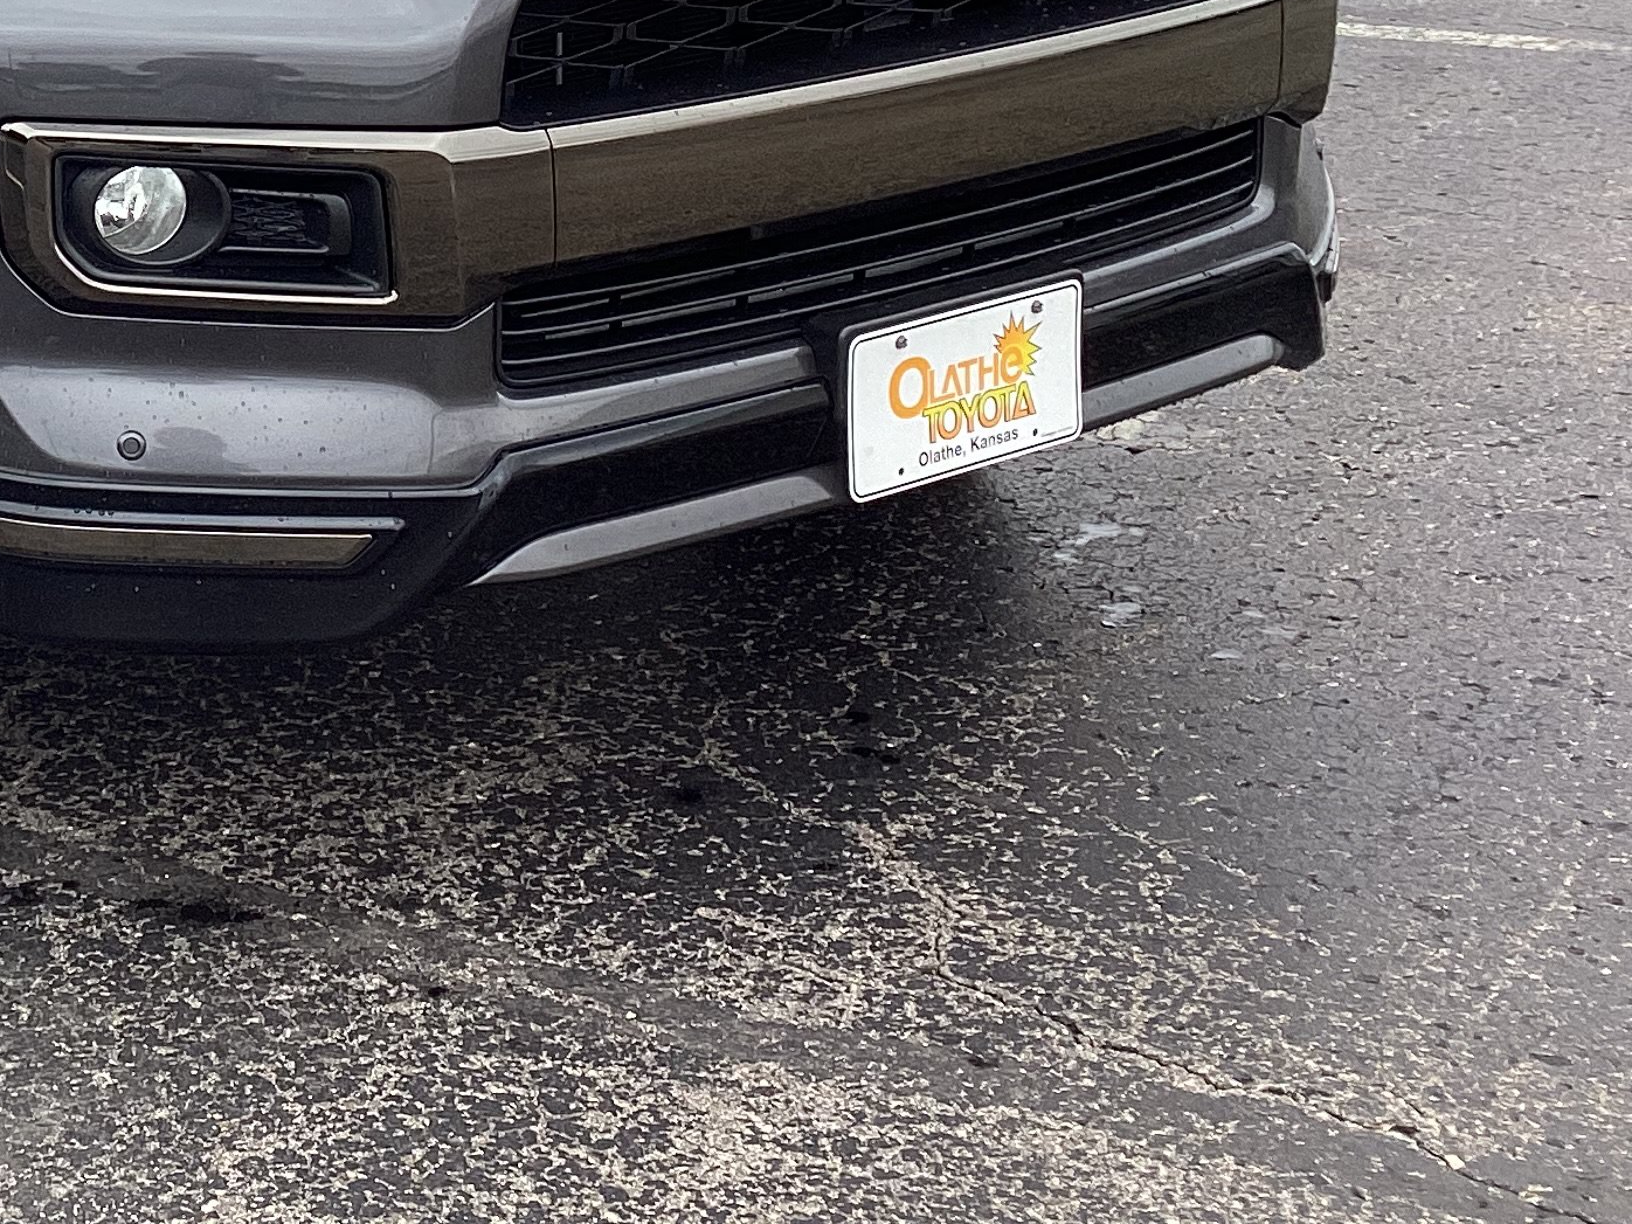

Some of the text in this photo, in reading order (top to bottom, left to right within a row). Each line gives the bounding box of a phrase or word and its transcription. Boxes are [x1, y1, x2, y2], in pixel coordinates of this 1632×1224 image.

[921, 380, 1037, 444] TOYOTA
[918, 445, 967, 467] Olathe,
[970, 428, 1019, 452] Kansas
